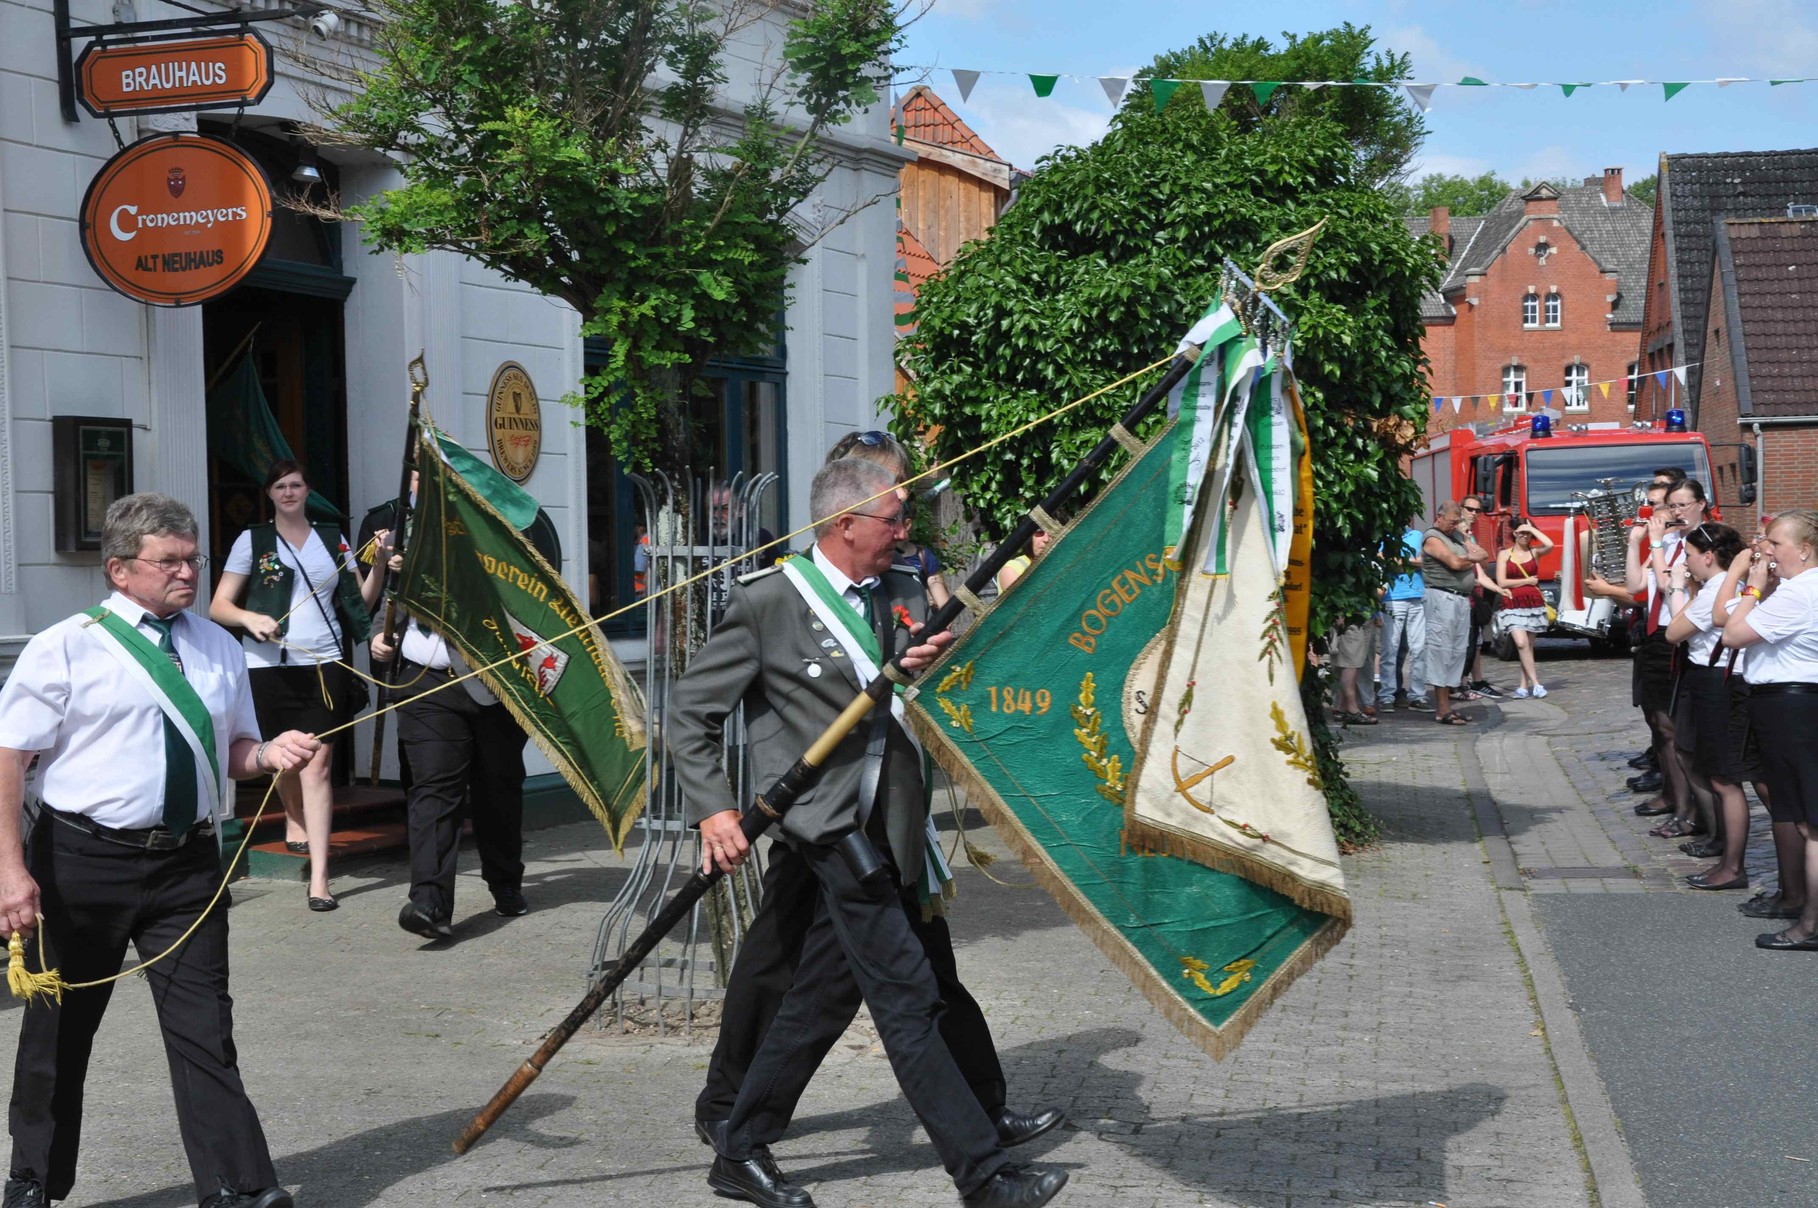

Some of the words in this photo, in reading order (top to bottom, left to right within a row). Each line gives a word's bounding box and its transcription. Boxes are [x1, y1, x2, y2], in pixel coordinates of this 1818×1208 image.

[121, 61, 227, 92] BRAUHAUS
[109, 204, 247, 242] Cronemeyers
[135, 255, 159, 272] ALT
[162, 249, 223, 272] NEUHAUS
[494, 417, 539, 431] GUINNESS
[986, 686, 1052, 716] 1849
